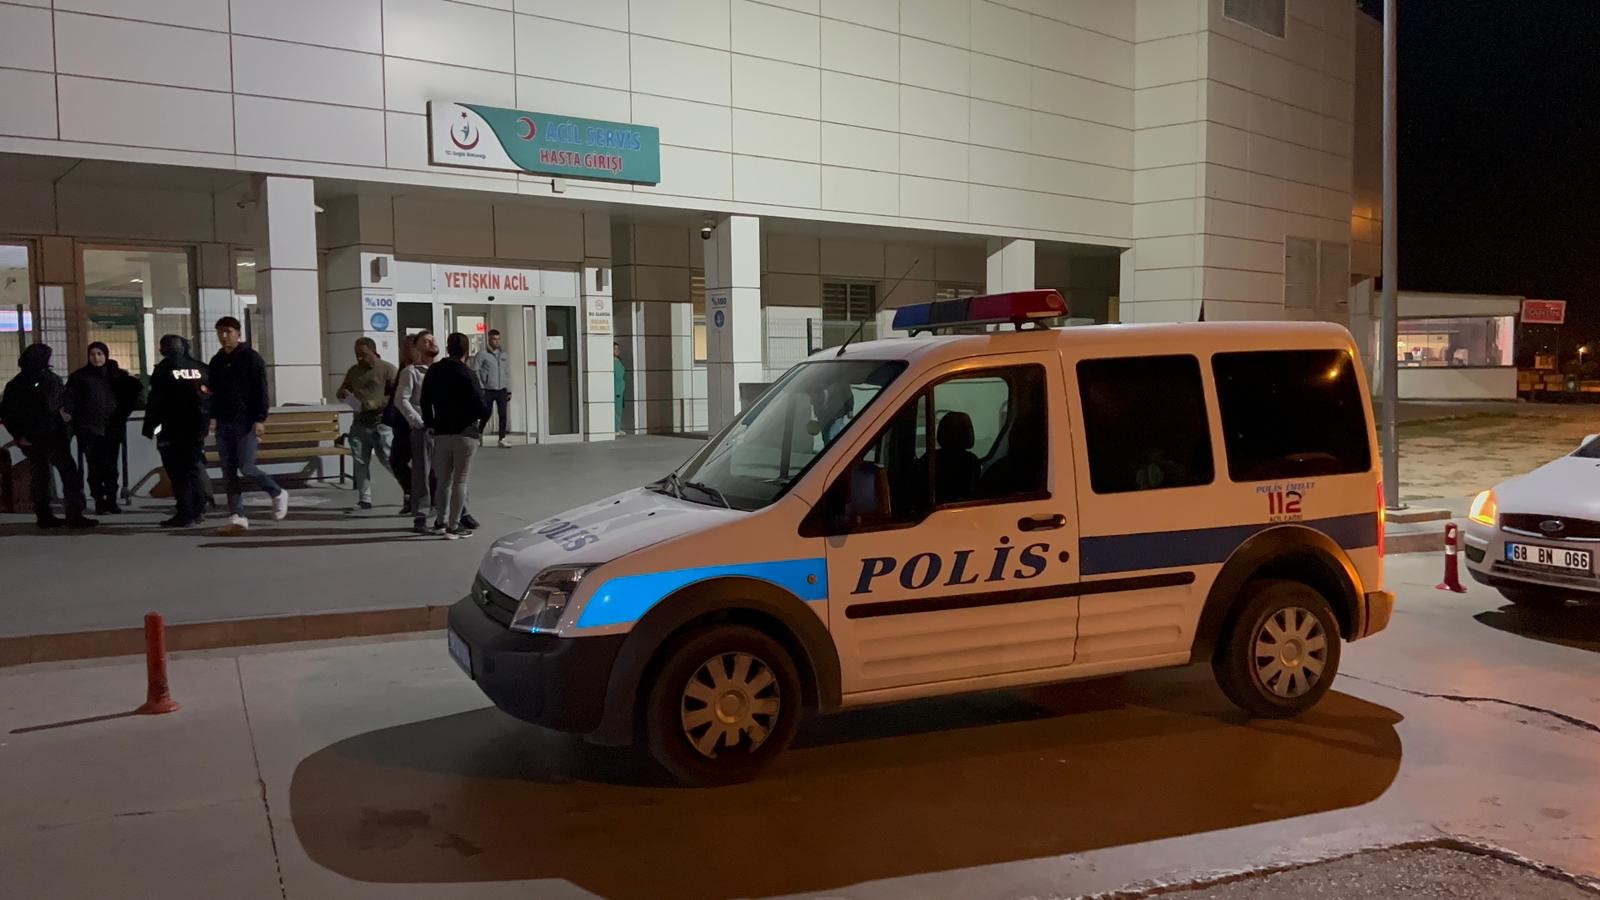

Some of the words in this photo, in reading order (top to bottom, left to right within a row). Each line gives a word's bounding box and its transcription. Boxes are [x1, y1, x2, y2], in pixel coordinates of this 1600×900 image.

[545, 120, 581, 145] ACİL
[587, 127, 641, 150] SERVİS
[540, 150, 580, 166] HASTA
[444, 271, 500, 293] YETİŞKİN
[503, 277, 529, 291] ACİL
[364, 297, 393, 307] %100
[1268, 491, 1302, 515] 112
[850, 535, 1050, 595] POLİS
[1513, 545, 1528, 561] 68
[1538, 548, 1553, 564] BN
[1564, 551, 1588, 568] 066
